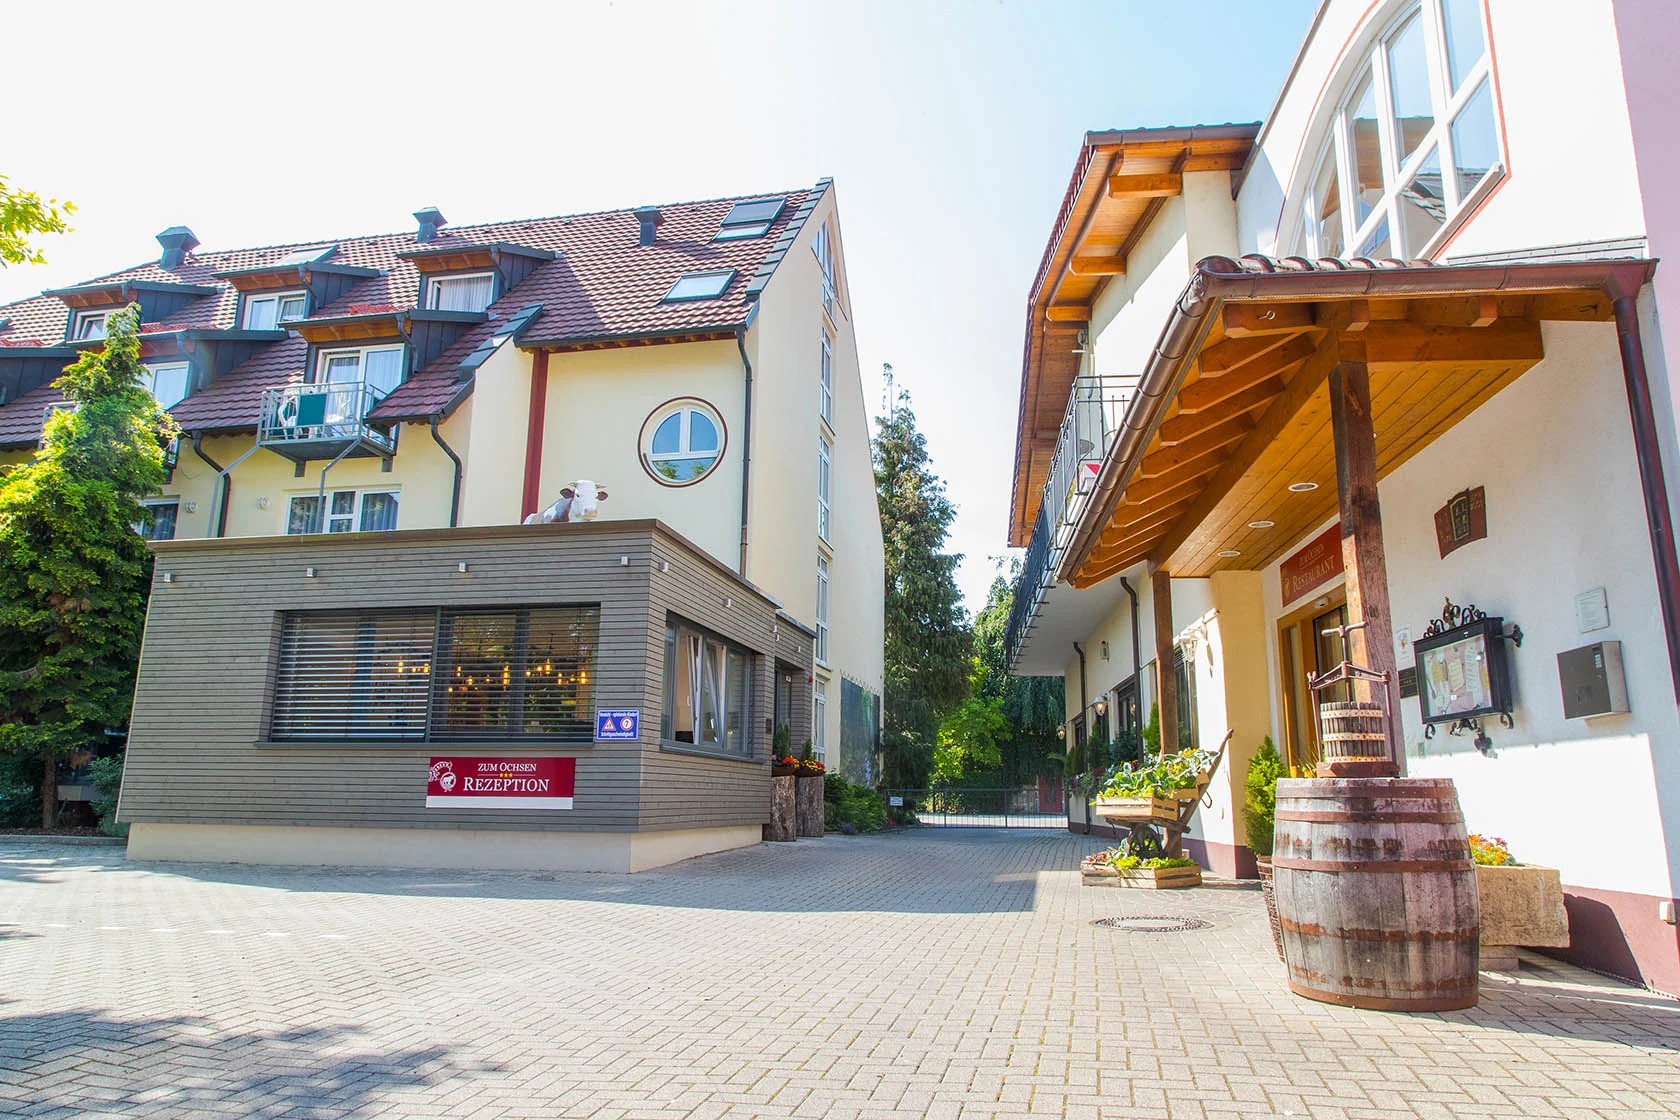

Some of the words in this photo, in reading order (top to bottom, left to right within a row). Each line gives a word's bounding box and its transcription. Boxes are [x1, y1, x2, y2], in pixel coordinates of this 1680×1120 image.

[1292, 555, 1335, 593] RESTAURANT
[477, 762, 497, 772] ZUM
[499, 762, 537, 772] OCHSEN
[463, 776, 550, 792] REZEPTION
